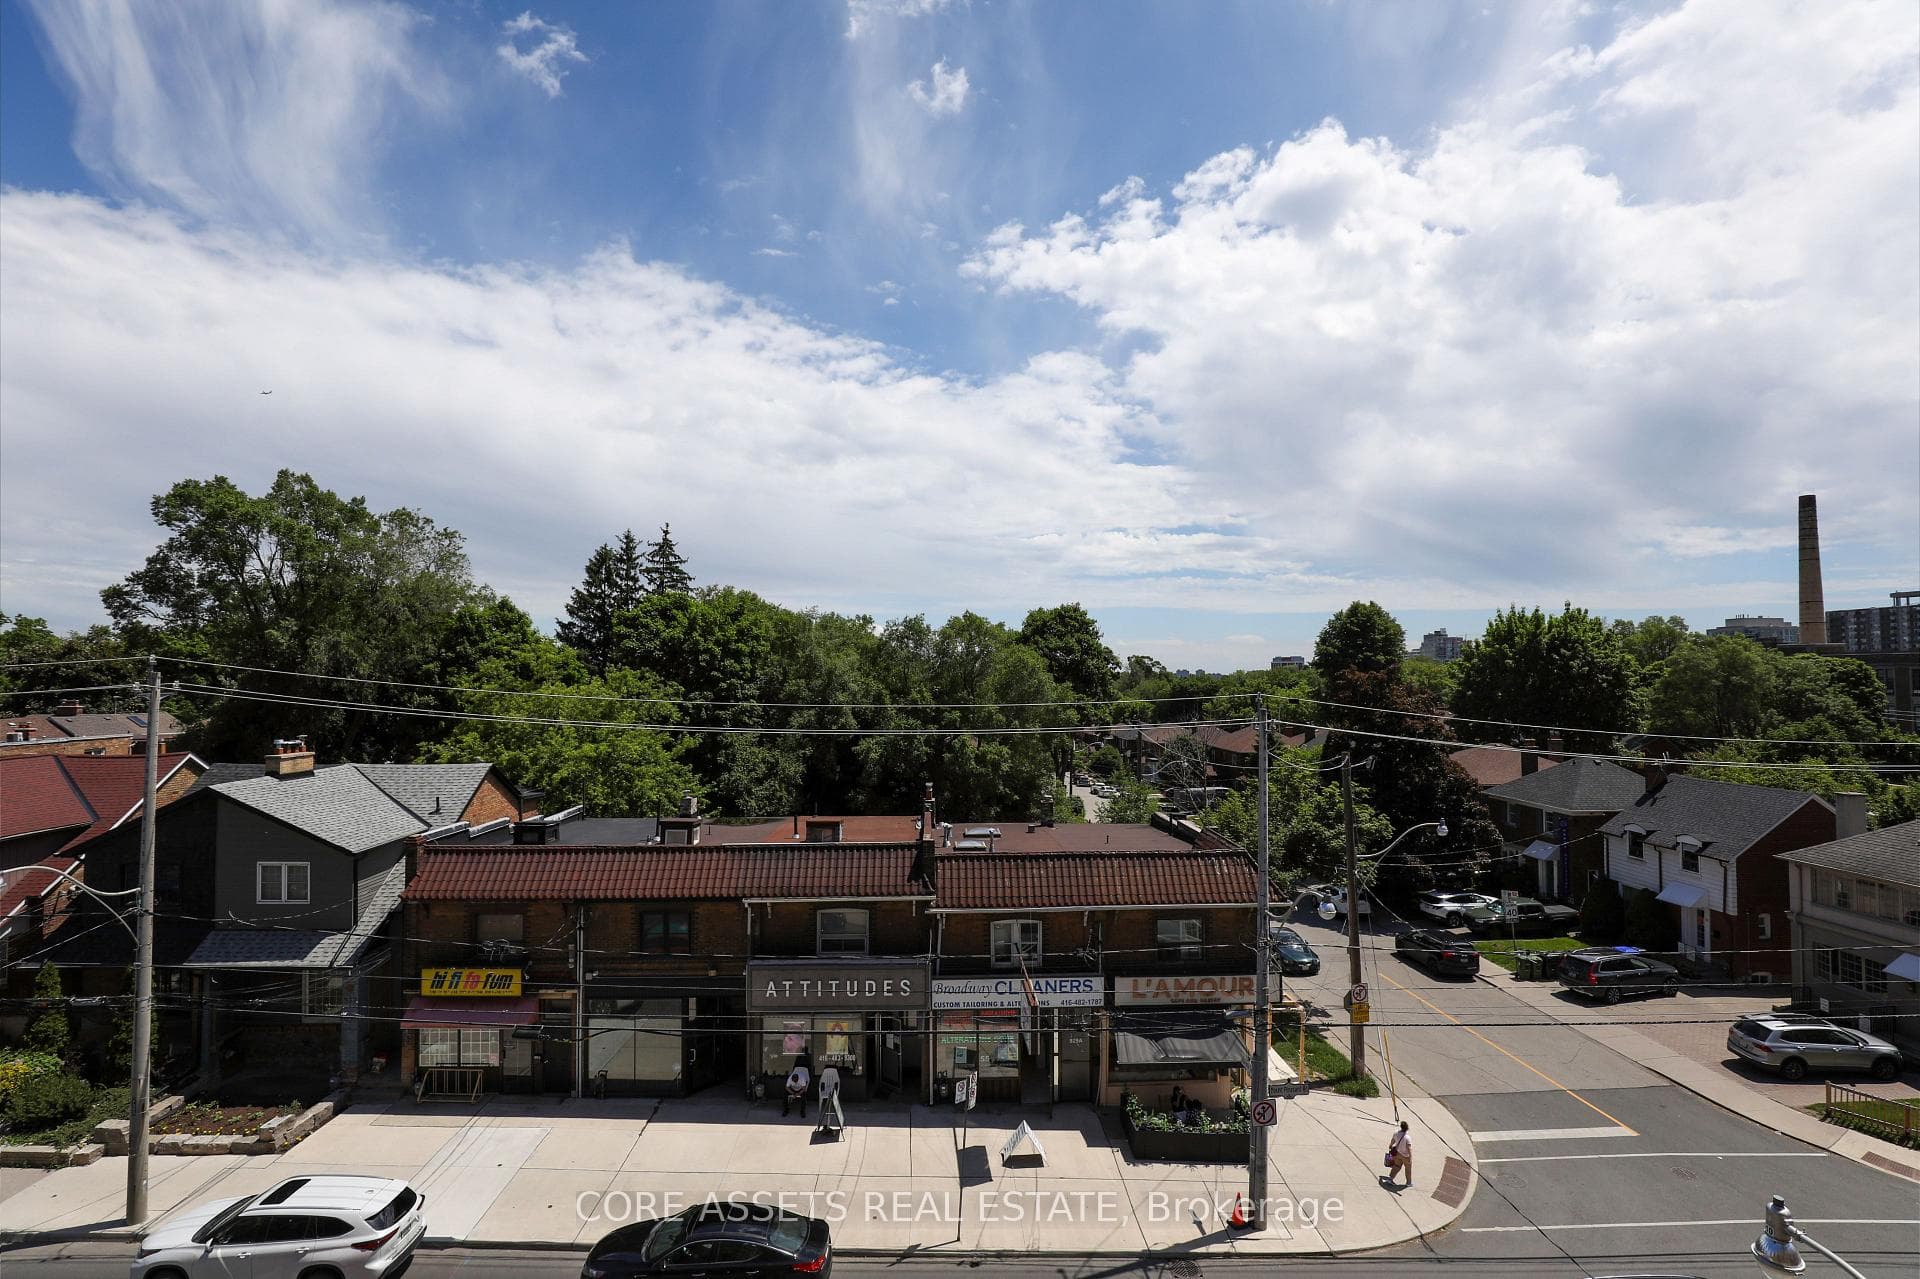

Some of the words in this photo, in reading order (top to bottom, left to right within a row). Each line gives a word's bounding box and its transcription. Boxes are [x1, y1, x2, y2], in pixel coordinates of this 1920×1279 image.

[430, 971, 447, 989] hi
[448, 971, 462, 989] fi
[482, 972, 513, 989] fum
[765, 979, 911, 997] ATTITUDES
[934, 981, 993, 998] Broadway
[994, 979, 1093, 995] CLANERS
[1132, 976, 1255, 999] L'AMOUR
[962, 1000, 998, 1008] TAILORING
